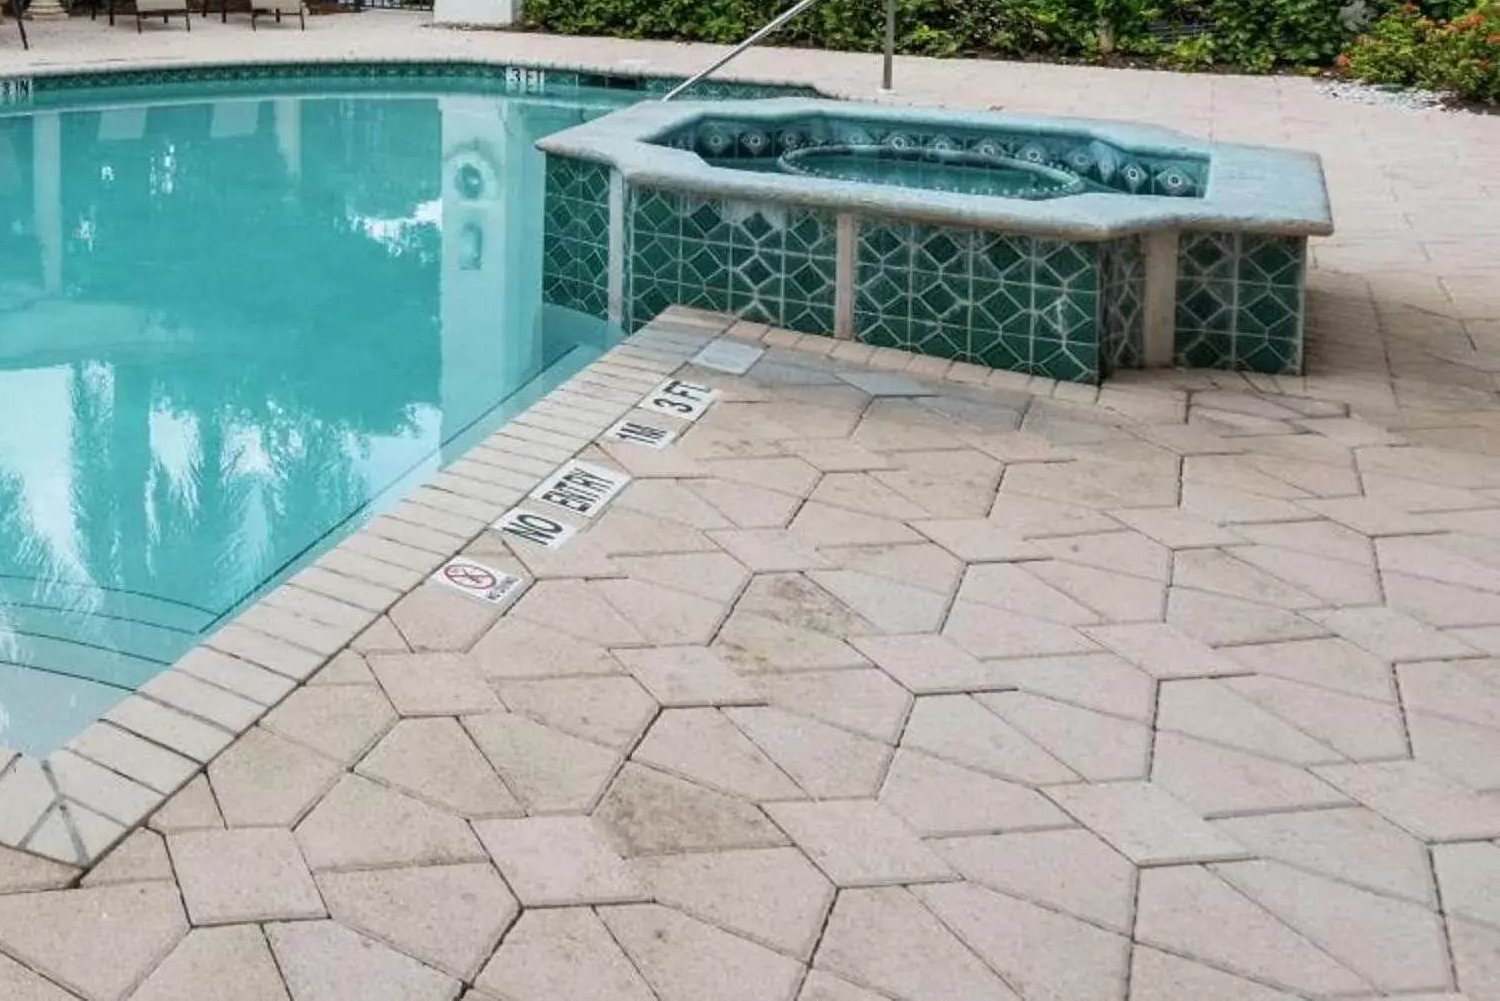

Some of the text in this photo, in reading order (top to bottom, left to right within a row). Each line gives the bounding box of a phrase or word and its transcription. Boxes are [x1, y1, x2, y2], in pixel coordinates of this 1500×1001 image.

[15, 80, 29, 96] IN
[653, 380, 713, 413] 3 FT
[502, 466, 615, 545] NO ENTRY
